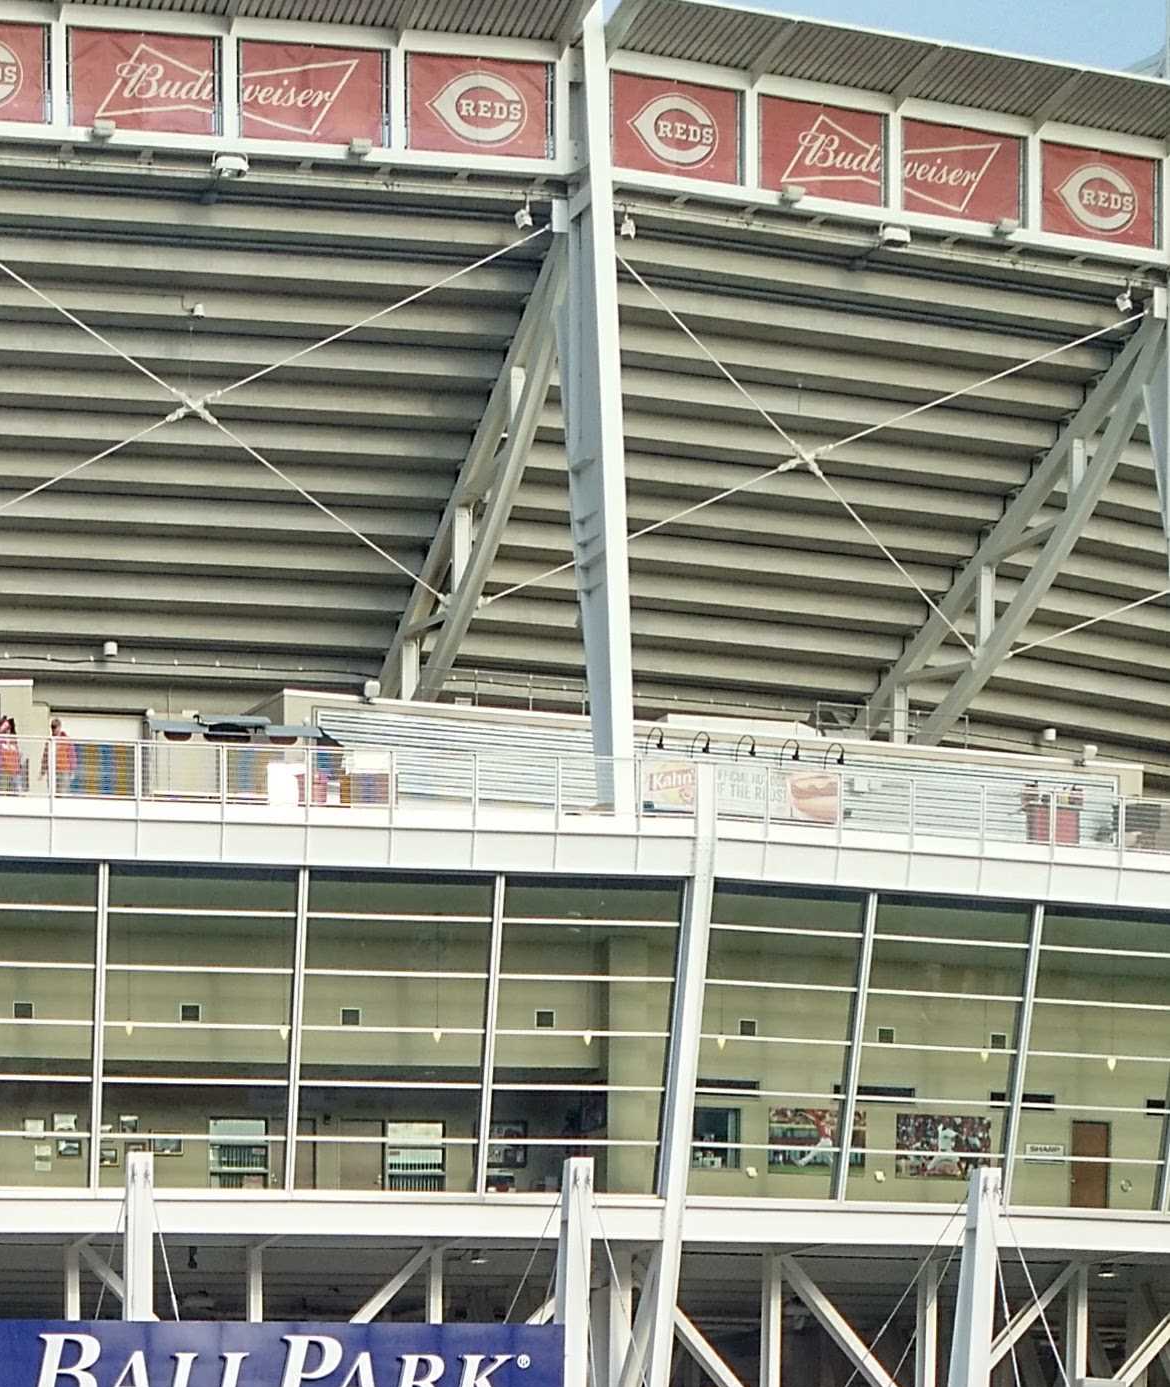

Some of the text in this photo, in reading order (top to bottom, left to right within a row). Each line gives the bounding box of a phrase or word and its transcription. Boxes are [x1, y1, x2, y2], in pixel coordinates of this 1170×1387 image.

[459, 99, 522, 121] REDS
[657, 121, 714, 145] REDS
[1081, 189, 1134, 212] REDS
